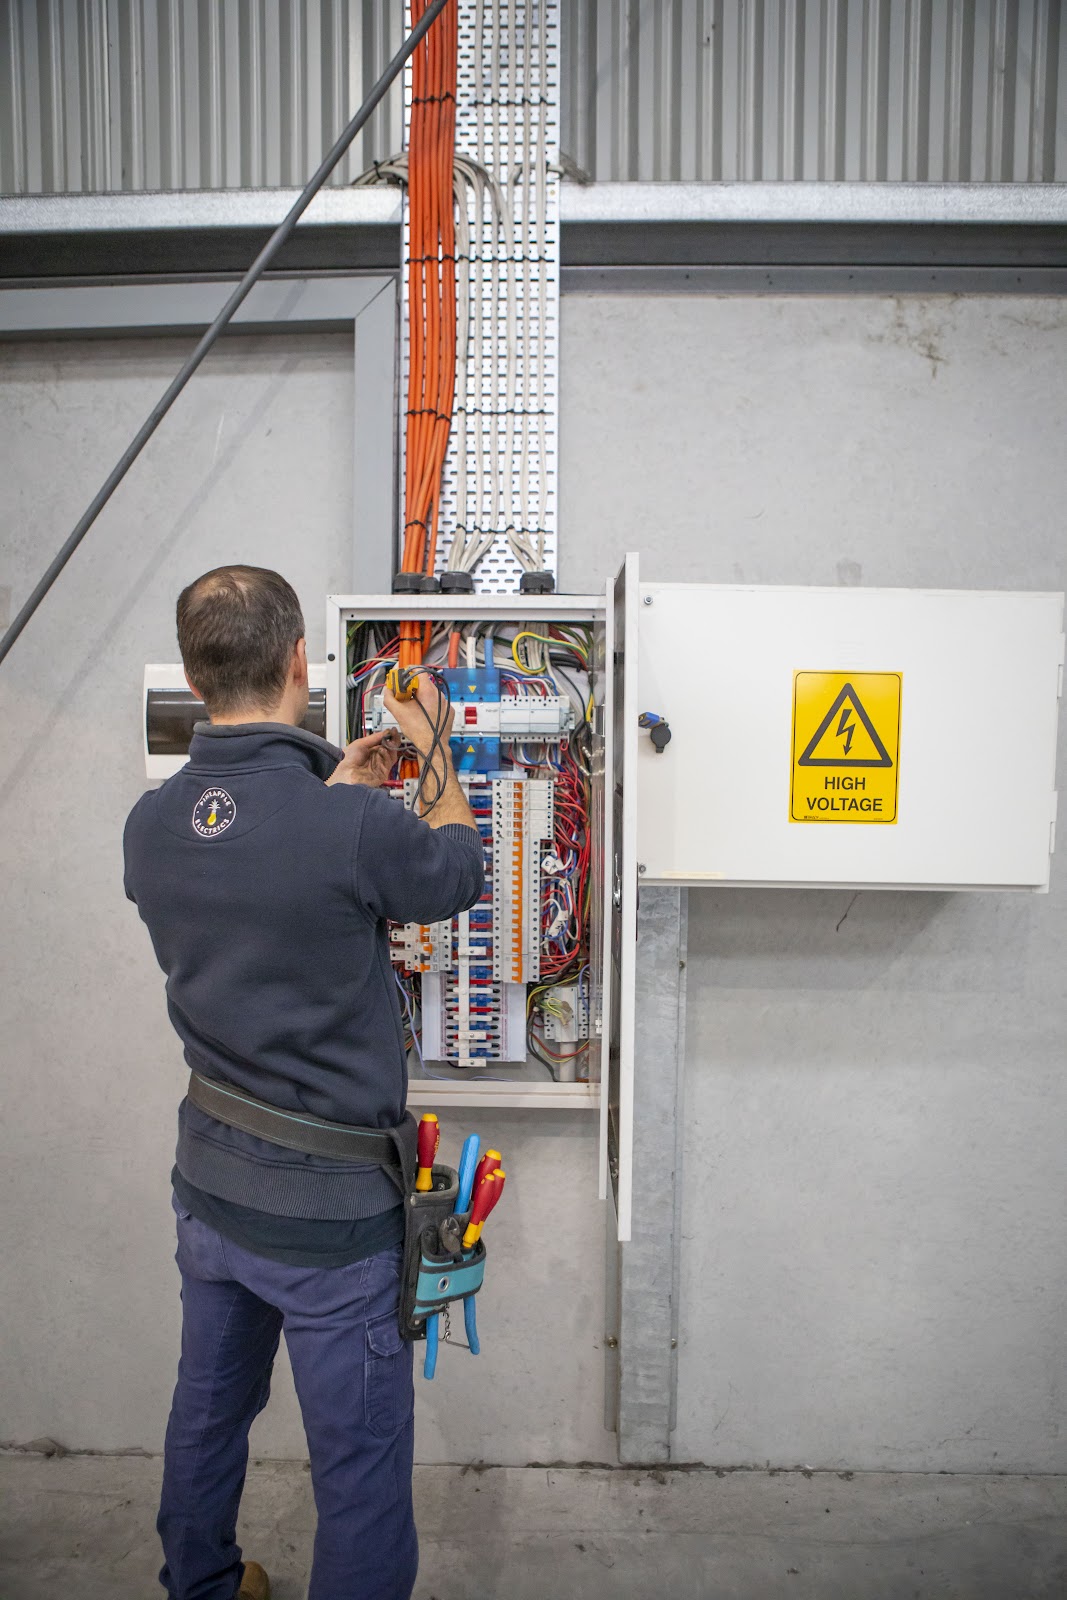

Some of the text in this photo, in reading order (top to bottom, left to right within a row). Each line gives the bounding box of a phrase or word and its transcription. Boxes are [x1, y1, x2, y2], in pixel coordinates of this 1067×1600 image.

[824, 776, 866, 790] HIGH
[200, 790, 231, 806] PINEAPPLE
[806, 797, 883, 812] VOLTAGE
[195, 819, 230, 834] ELECTRICS
